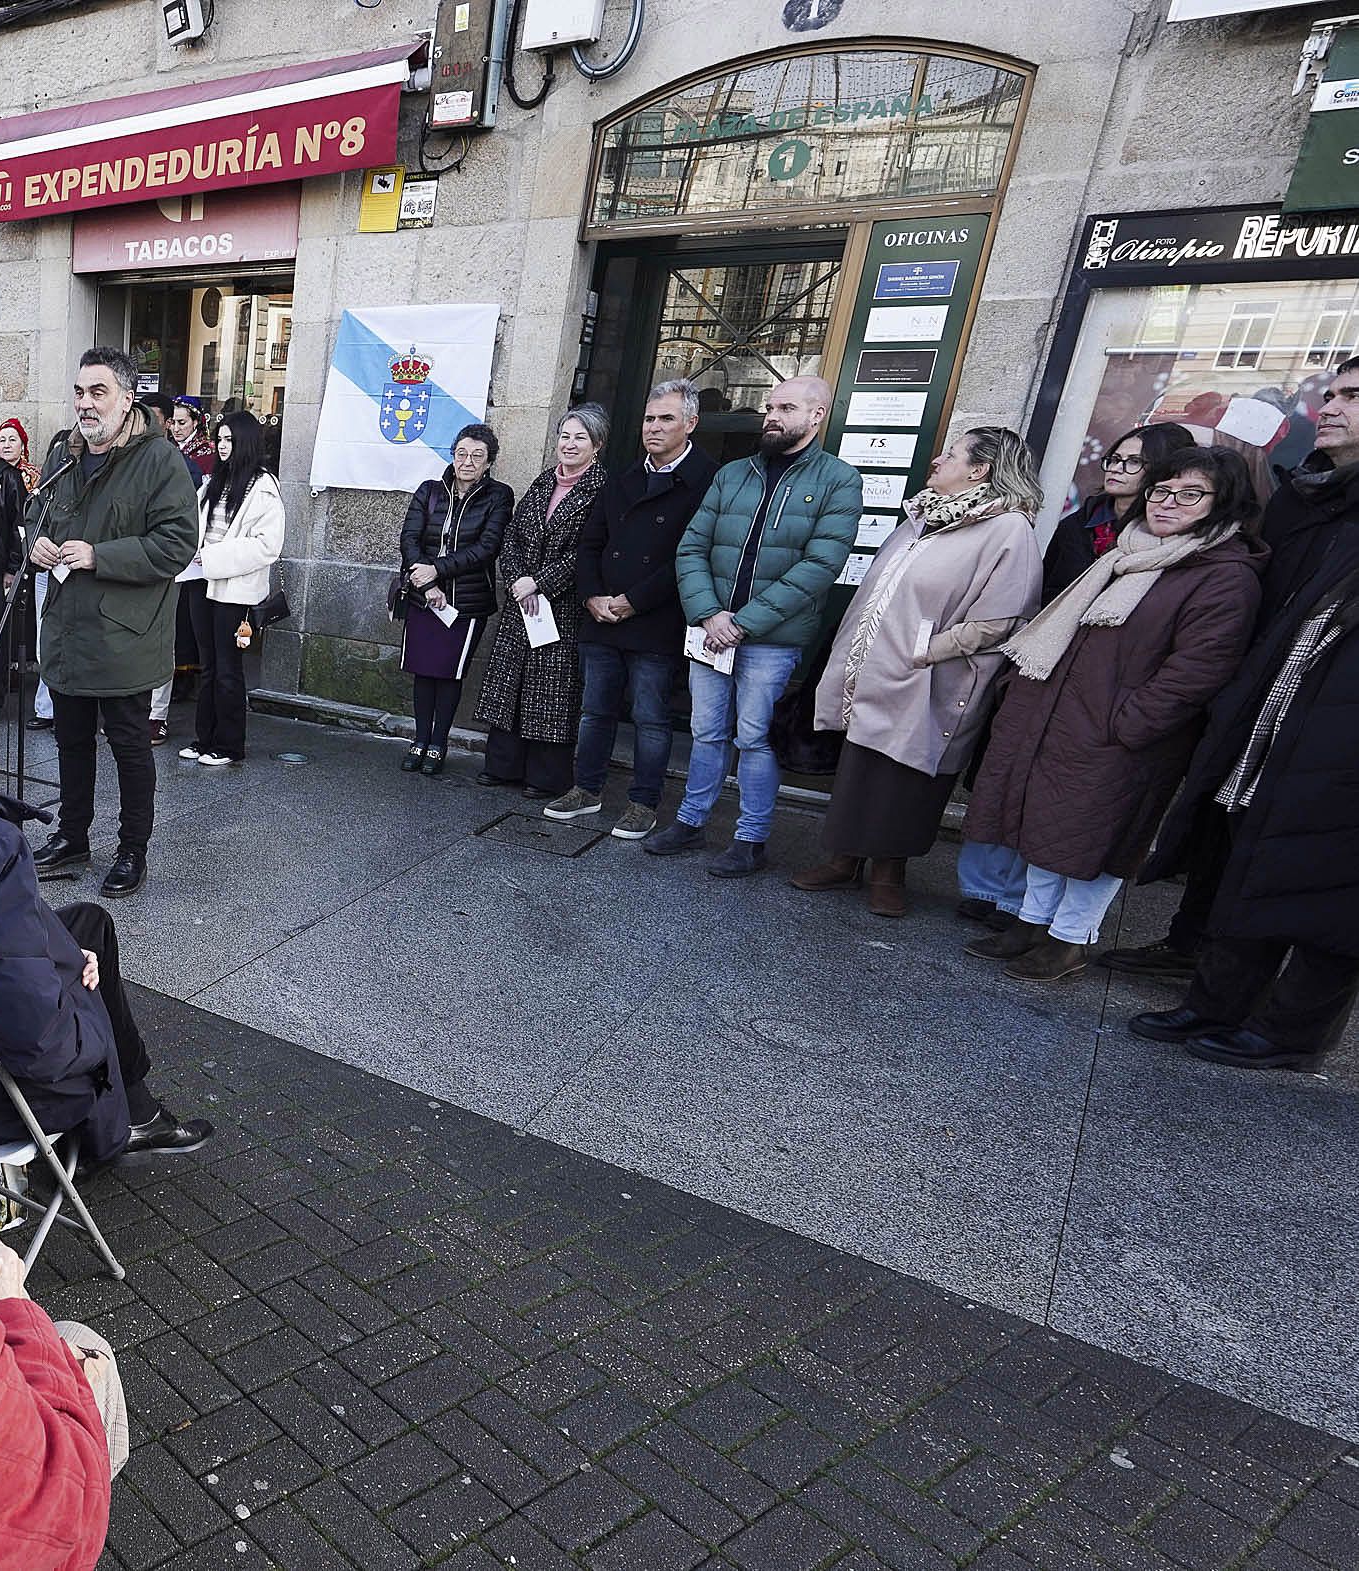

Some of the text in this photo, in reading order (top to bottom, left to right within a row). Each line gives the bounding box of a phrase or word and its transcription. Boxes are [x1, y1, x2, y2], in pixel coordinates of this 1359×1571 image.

[673, 93, 933, 141] PLAZA DE ESPAÑA
[24, 123, 283, 208] EXPENDEDURÍA
[778, 145, 797, 173] 1
[125, 232, 234, 262] TABACOS
[884, 228, 969, 247] OFICINAS
[1111, 239, 1225, 267] Olimpio
[869, 438, 887, 448] T.S.
